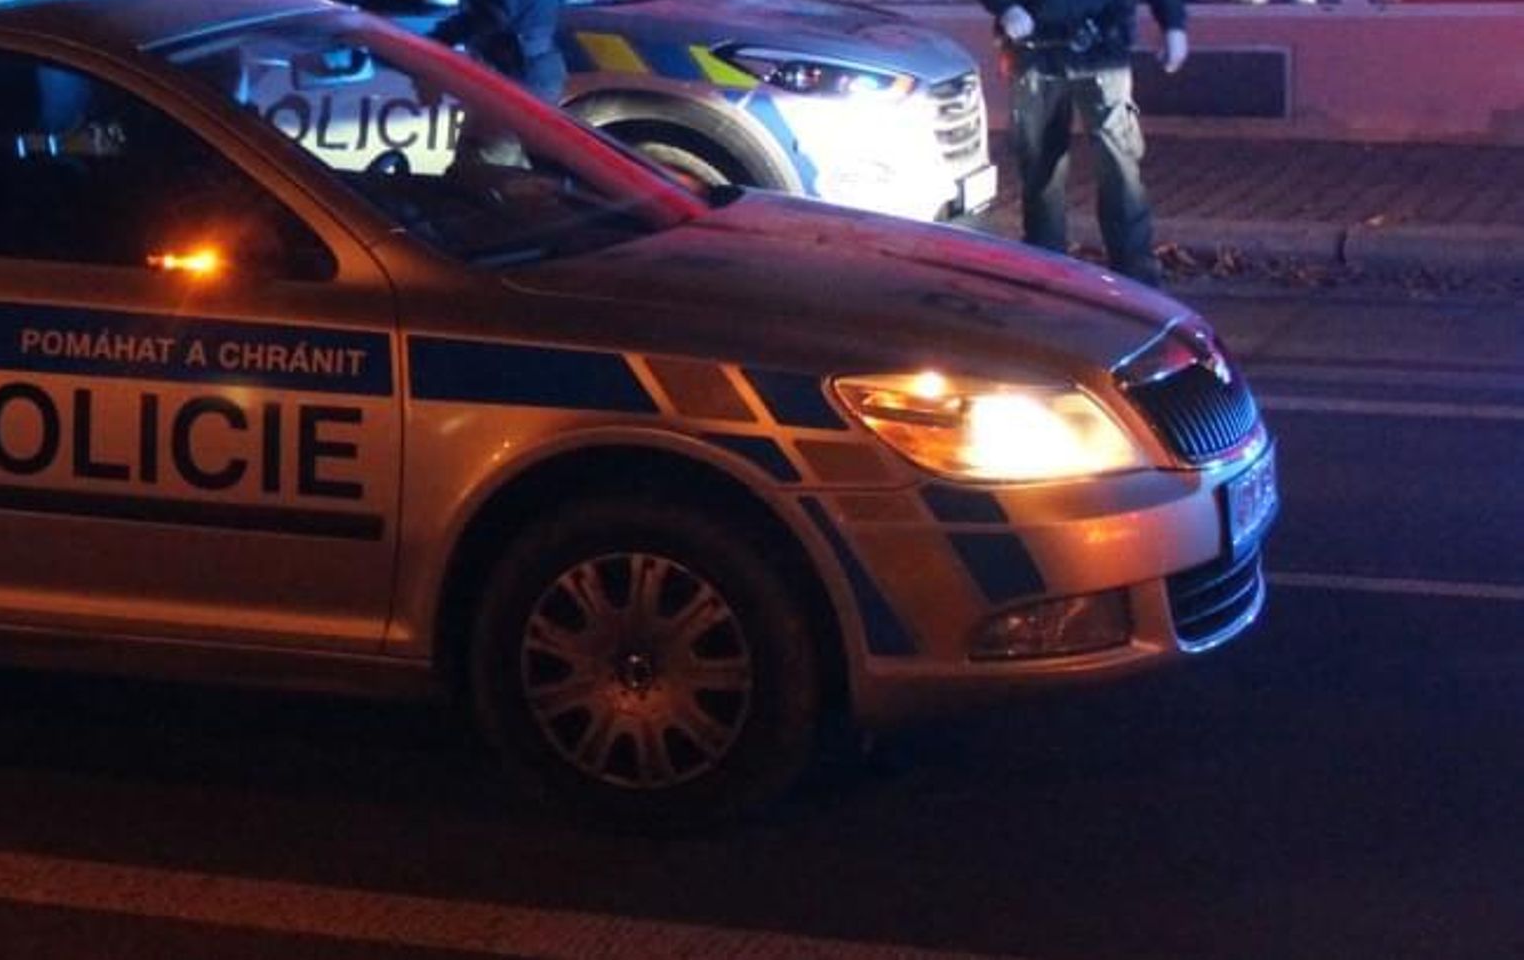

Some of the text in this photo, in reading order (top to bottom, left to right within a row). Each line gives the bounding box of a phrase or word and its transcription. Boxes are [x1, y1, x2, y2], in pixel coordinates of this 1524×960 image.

[21, 322, 368, 377] POMÁHAT A CHRÁNIT
